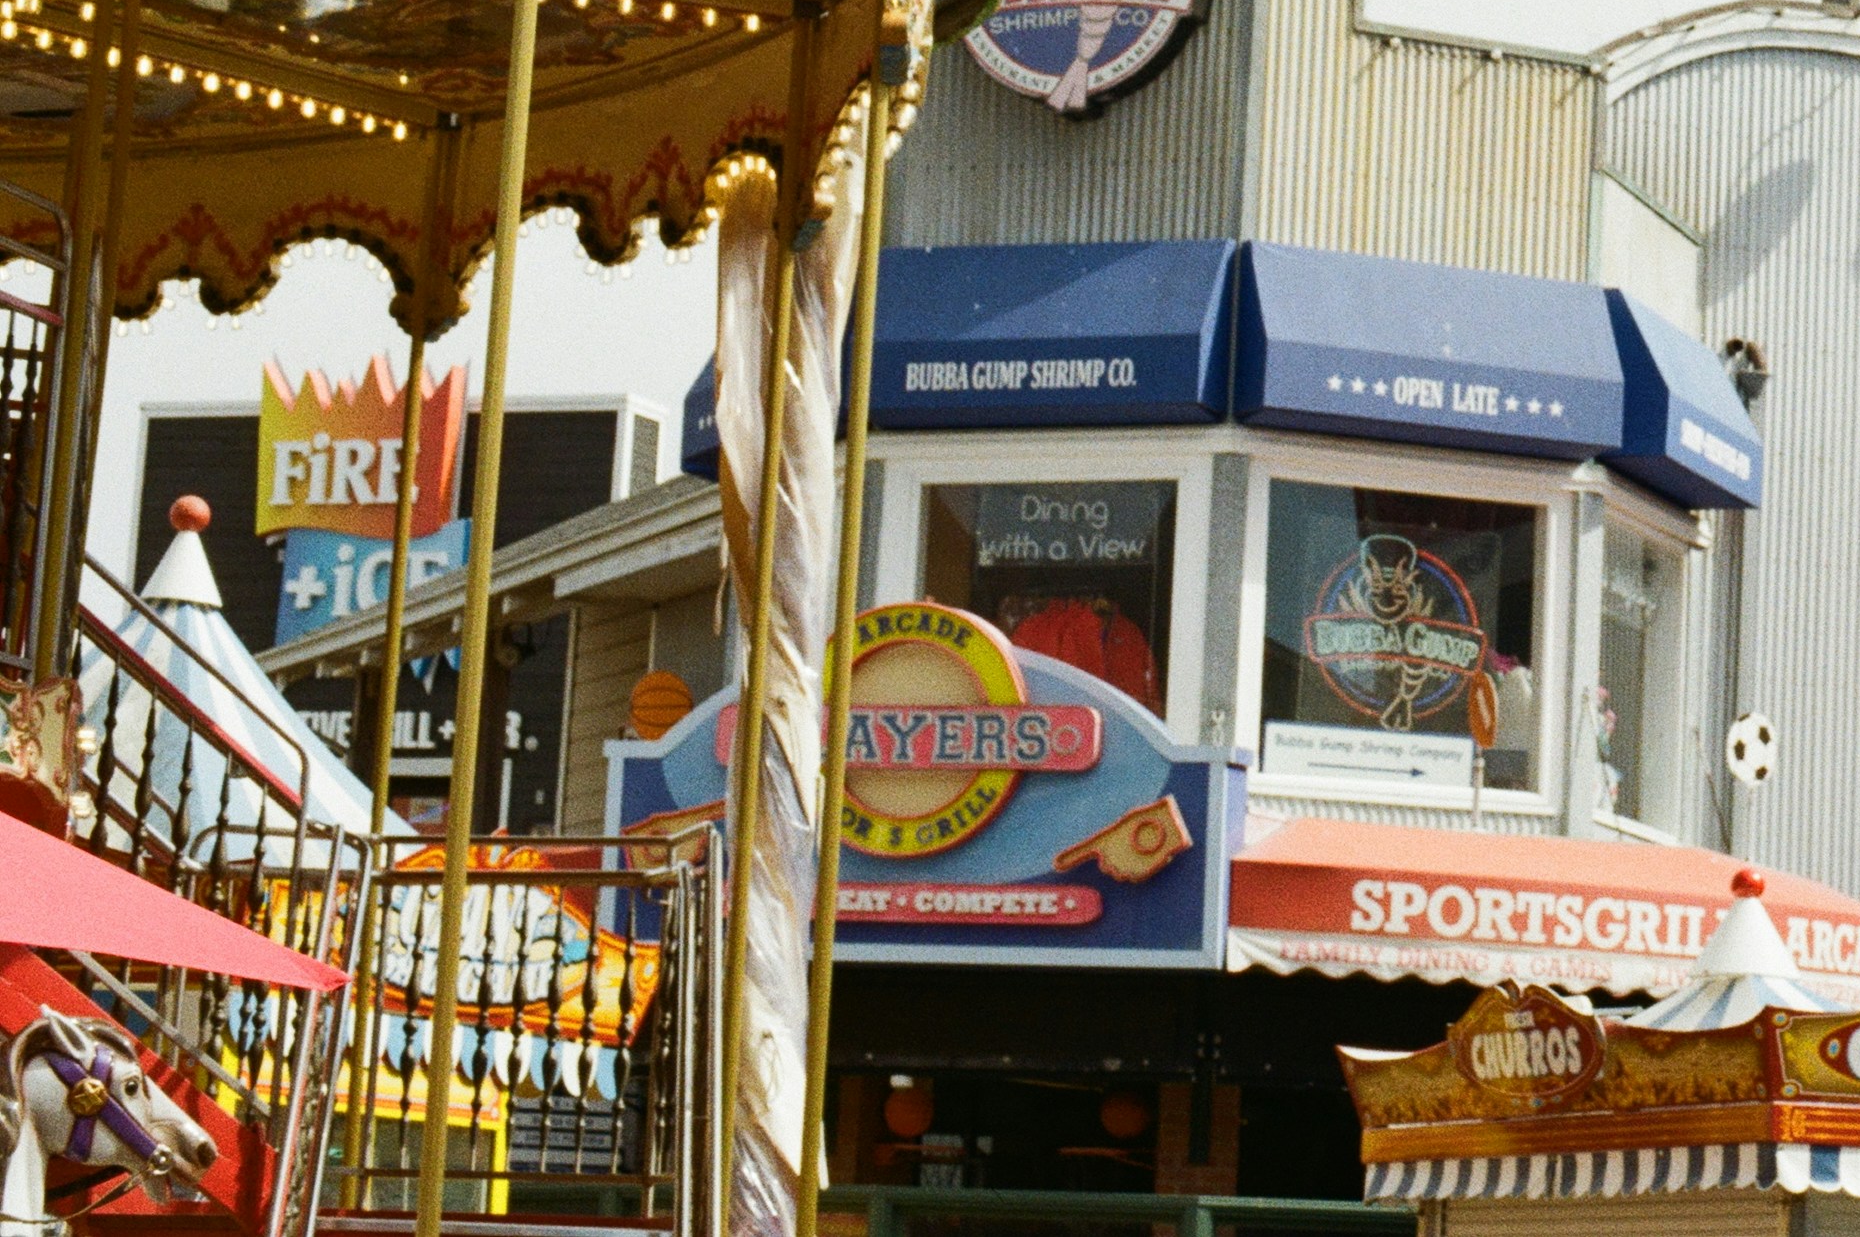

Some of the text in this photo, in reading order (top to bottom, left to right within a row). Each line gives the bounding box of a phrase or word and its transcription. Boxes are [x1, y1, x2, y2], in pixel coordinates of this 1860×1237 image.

[989, 9, 1079, 34] SHRIMP
[905, 357, 1137, 391] BUBBA GUMP SHRIMP CO.
[1393, 376, 1500, 416] OPEN LATE
[1021, 494, 1109, 529] Dining
[981, 531, 1146, 560] with a View
[858, 612, 973, 649] ARCADE
[848, 712, 1051, 763] AYERS
[915, 784, 996, 846] GRILL
[914, 890, 1058, 916] COMPETE
[1279, 940, 1382, 965] FAMILY
[1395, 948, 1490, 973] DINING
[1529, 957, 1613, 982] GAMES
[1471, 1025, 1583, 1080] CHURROS
